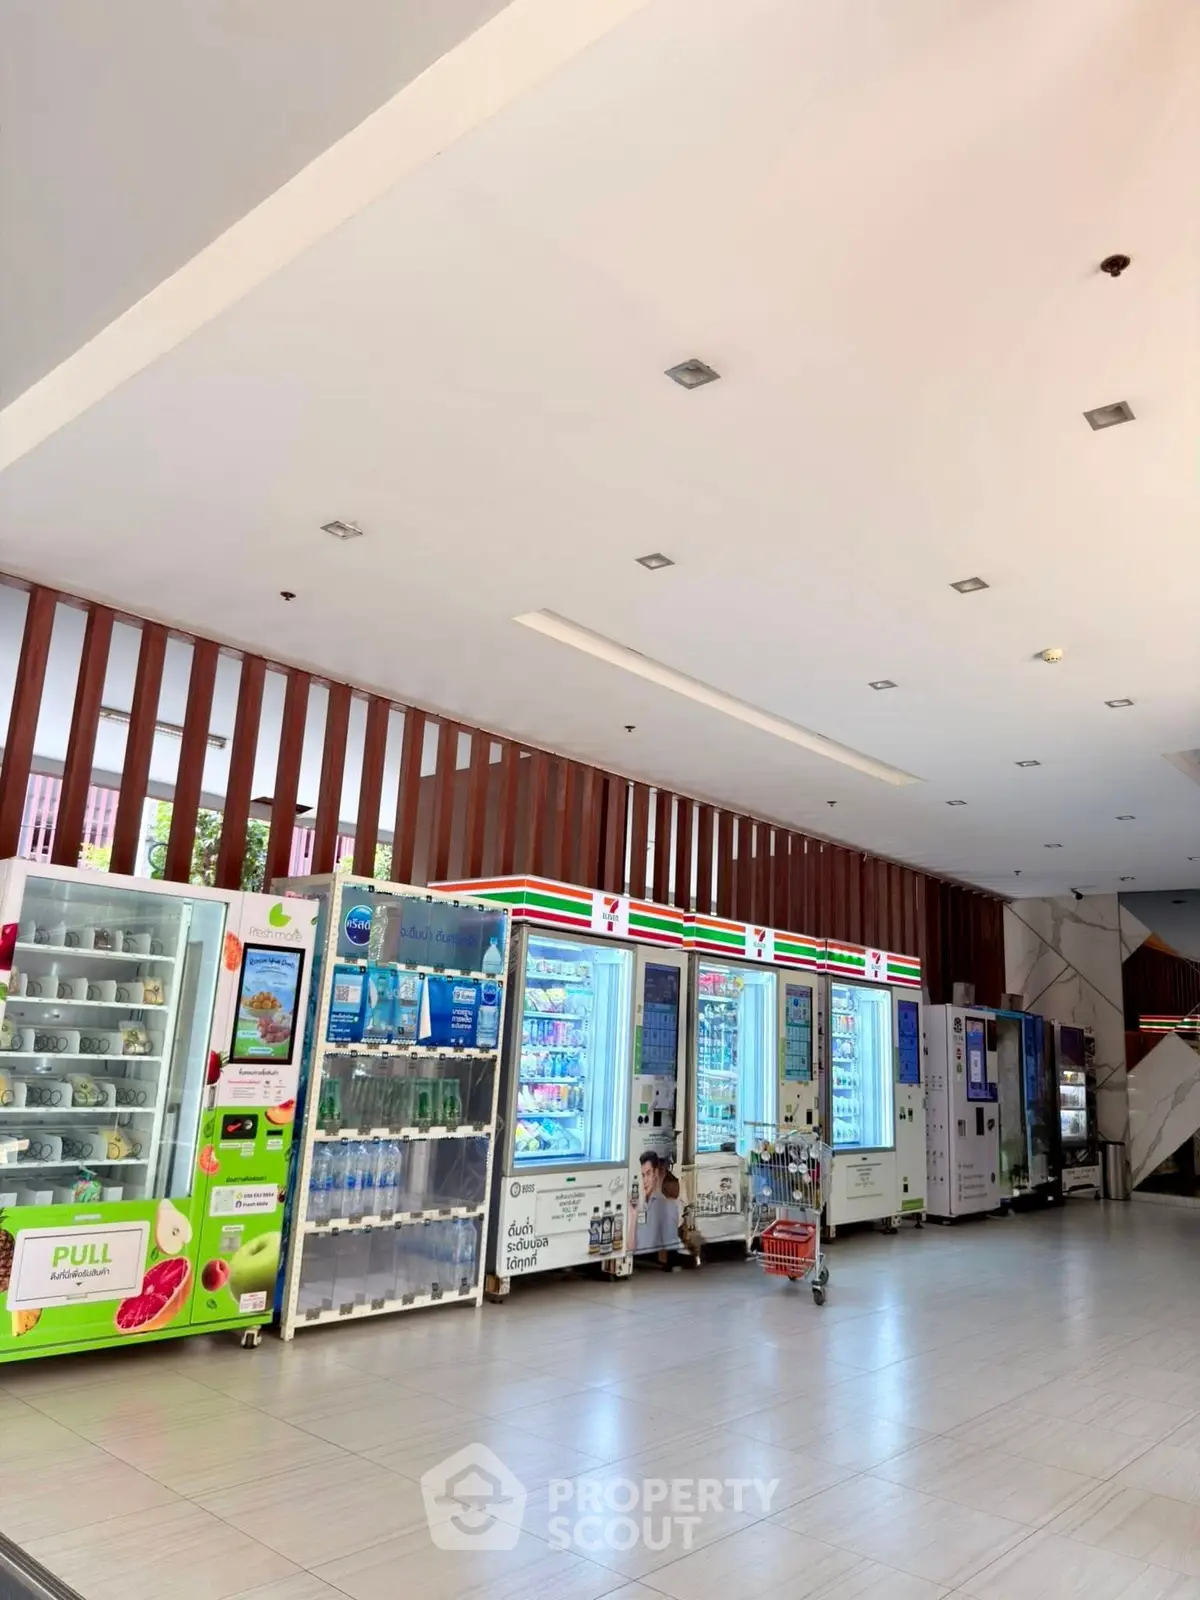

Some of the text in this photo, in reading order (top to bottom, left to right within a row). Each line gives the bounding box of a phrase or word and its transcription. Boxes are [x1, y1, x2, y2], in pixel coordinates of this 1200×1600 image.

[507, 1217, 534, 1237] ดื่มด่ำ
[52, 1243, 112, 1268] PULL
[506, 1250, 538, 1271] ได้ทุกที่
